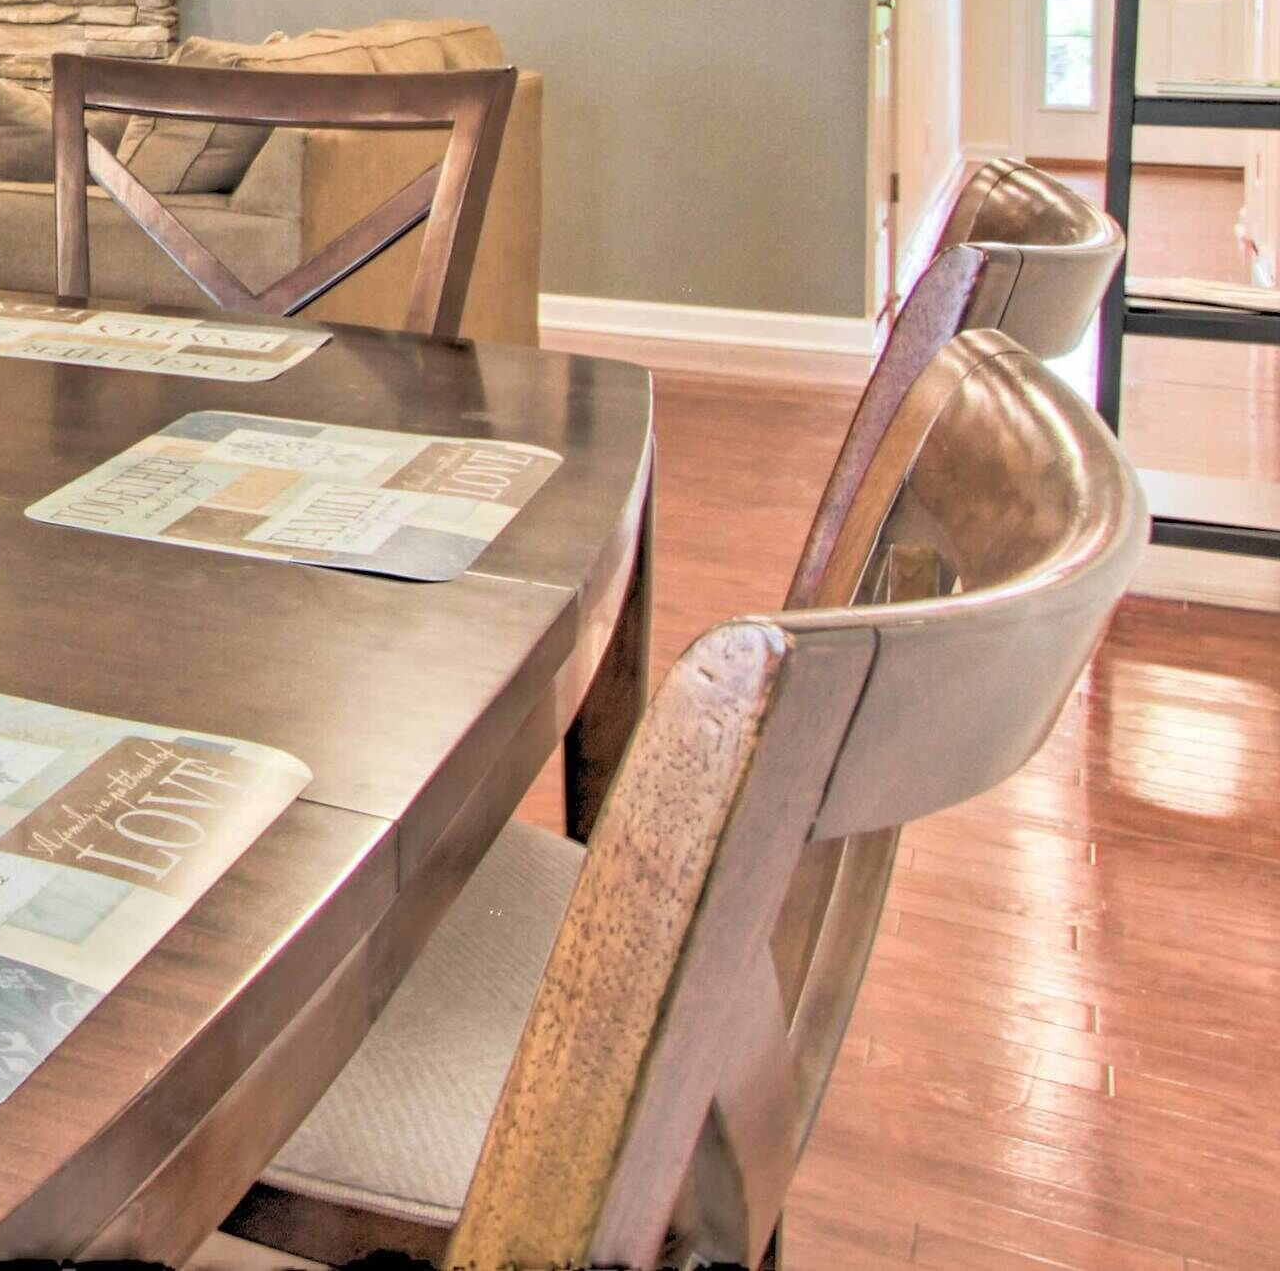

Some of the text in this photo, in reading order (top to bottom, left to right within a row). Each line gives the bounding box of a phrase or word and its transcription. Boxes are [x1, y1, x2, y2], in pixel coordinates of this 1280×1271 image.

[49, 457, 200, 525] TOGETHER
[438, 449, 535, 500] LOVE
[267, 484, 385, 548] FAMILY
[53, 803, 115, 852] family
[75, 756, 242, 883] LOVE
